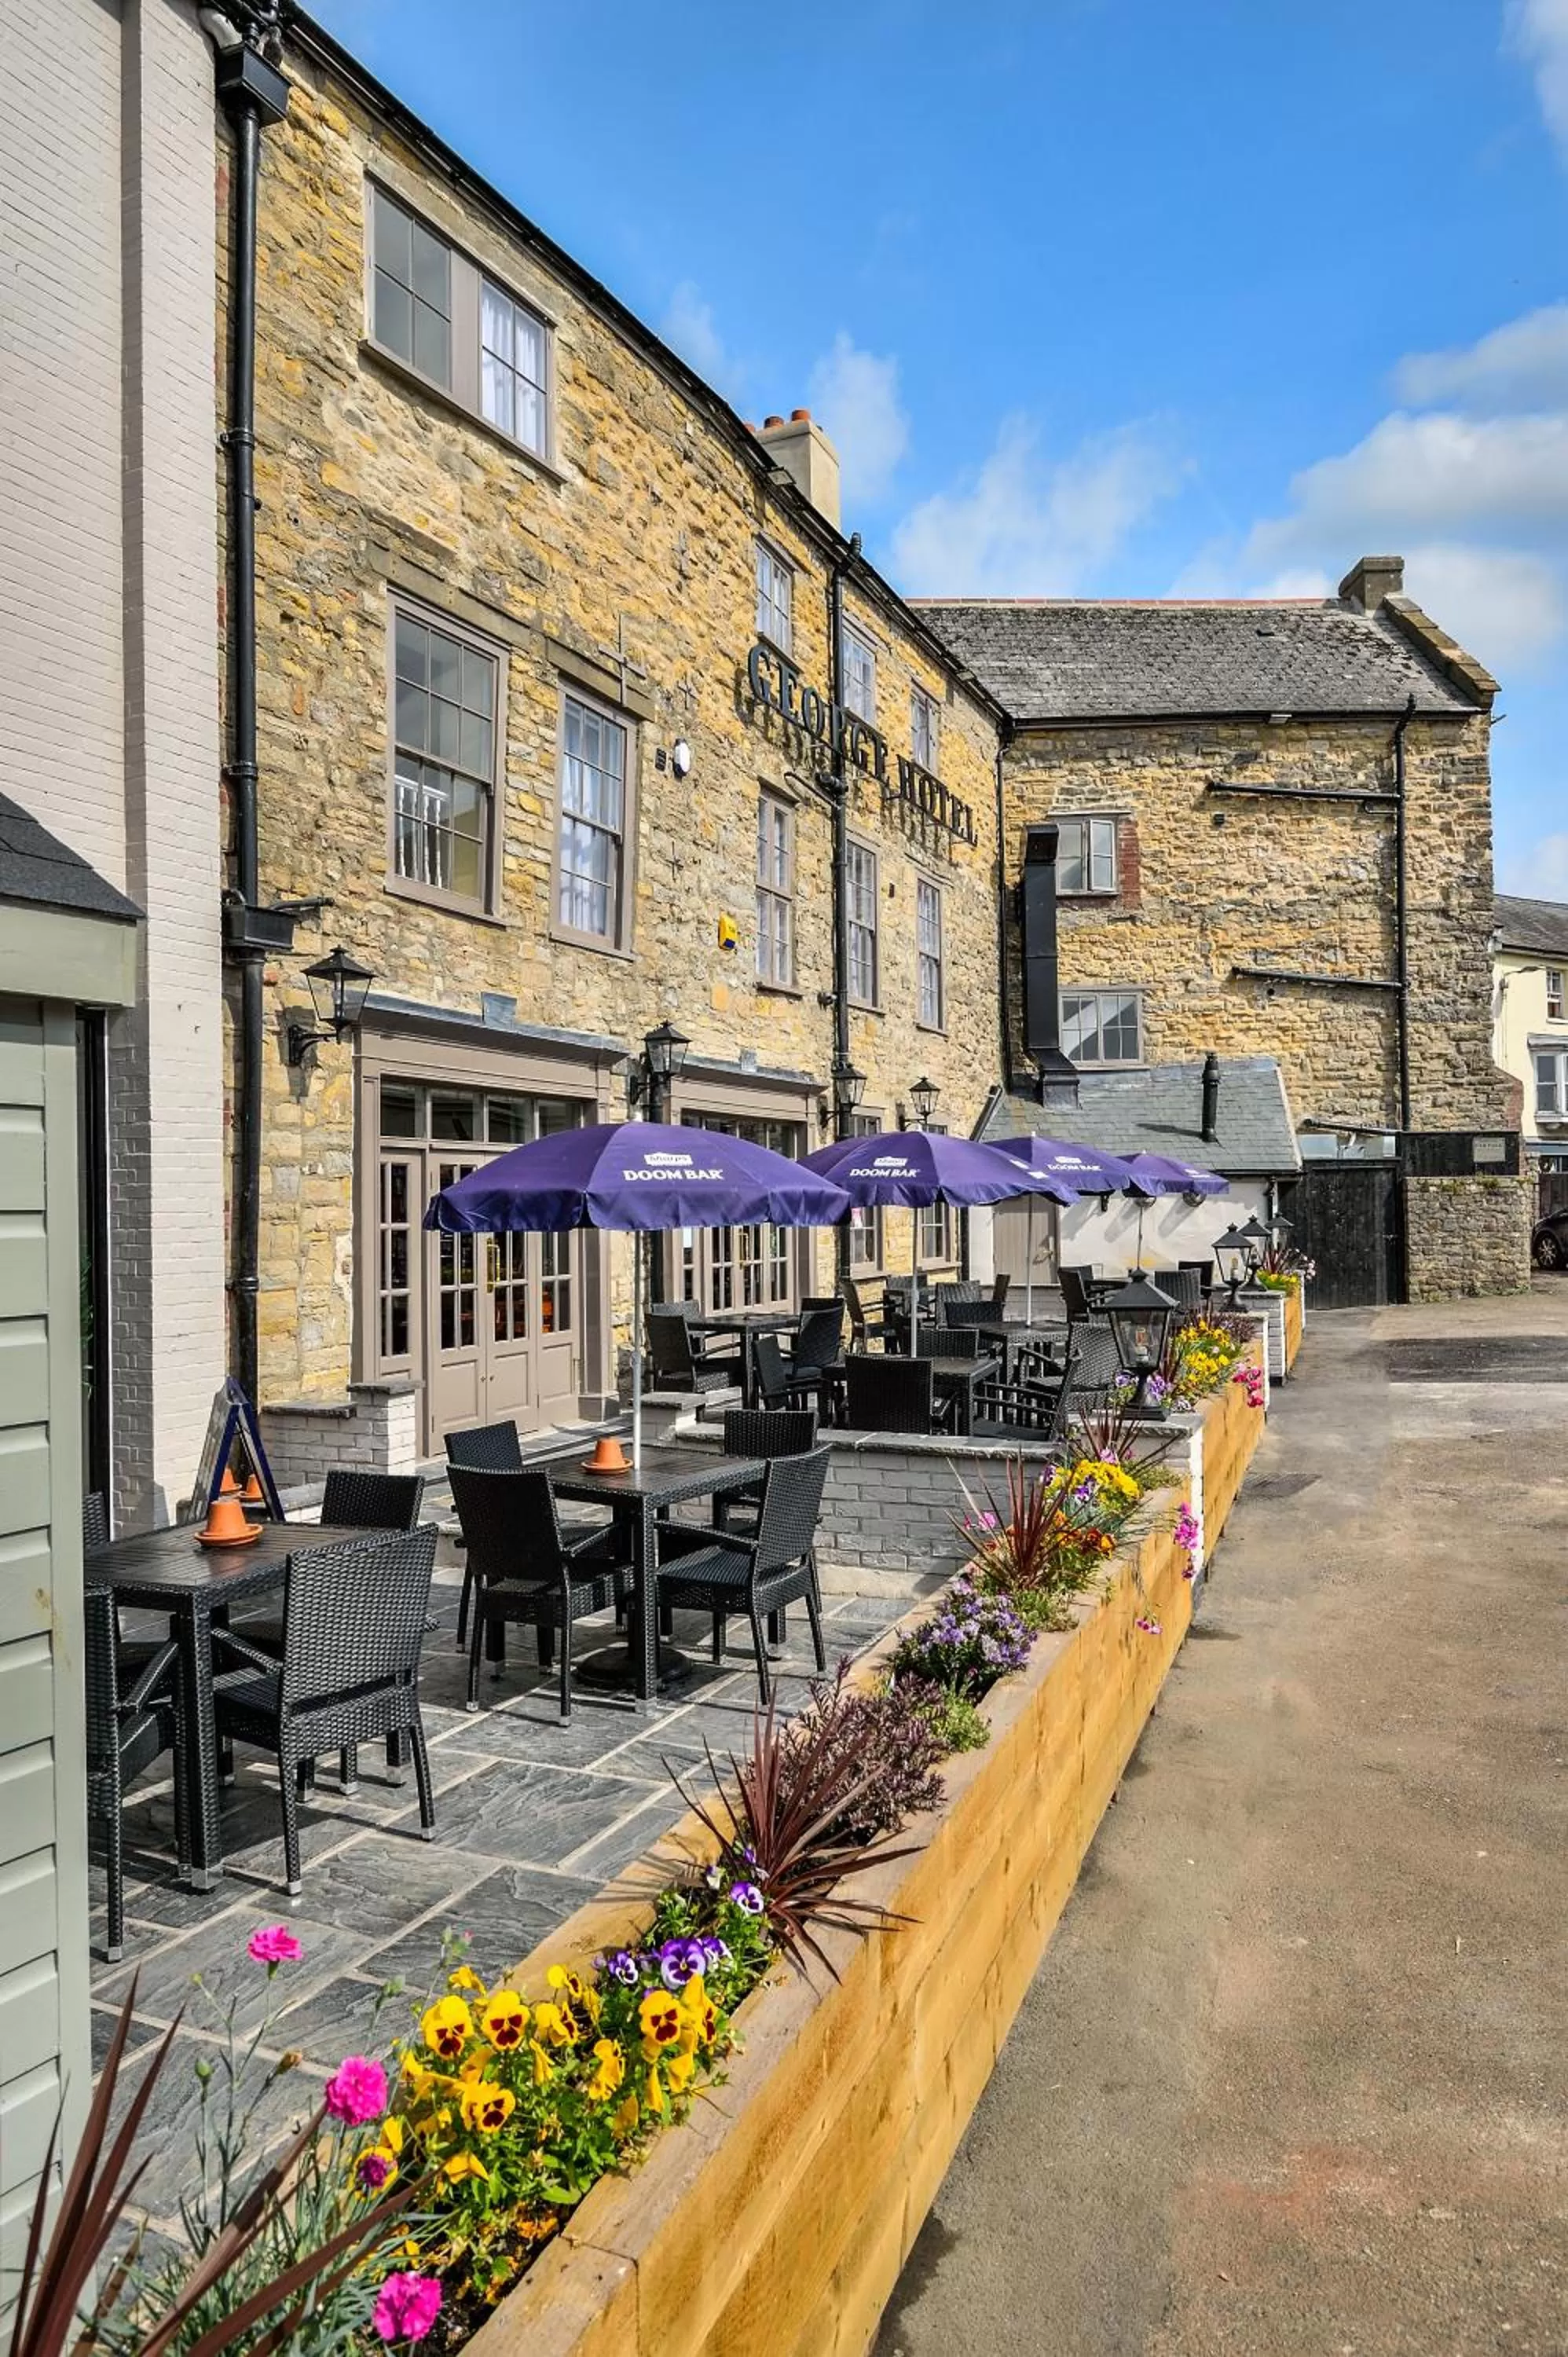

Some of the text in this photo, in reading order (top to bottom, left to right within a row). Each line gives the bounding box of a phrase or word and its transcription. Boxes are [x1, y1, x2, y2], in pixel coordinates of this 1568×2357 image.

[748, 643, 978, 847] GEORGE HOTEL
[622, 1168, 724, 1181] DOOM BAR
[891, 1168, 917, 1178] BAR
